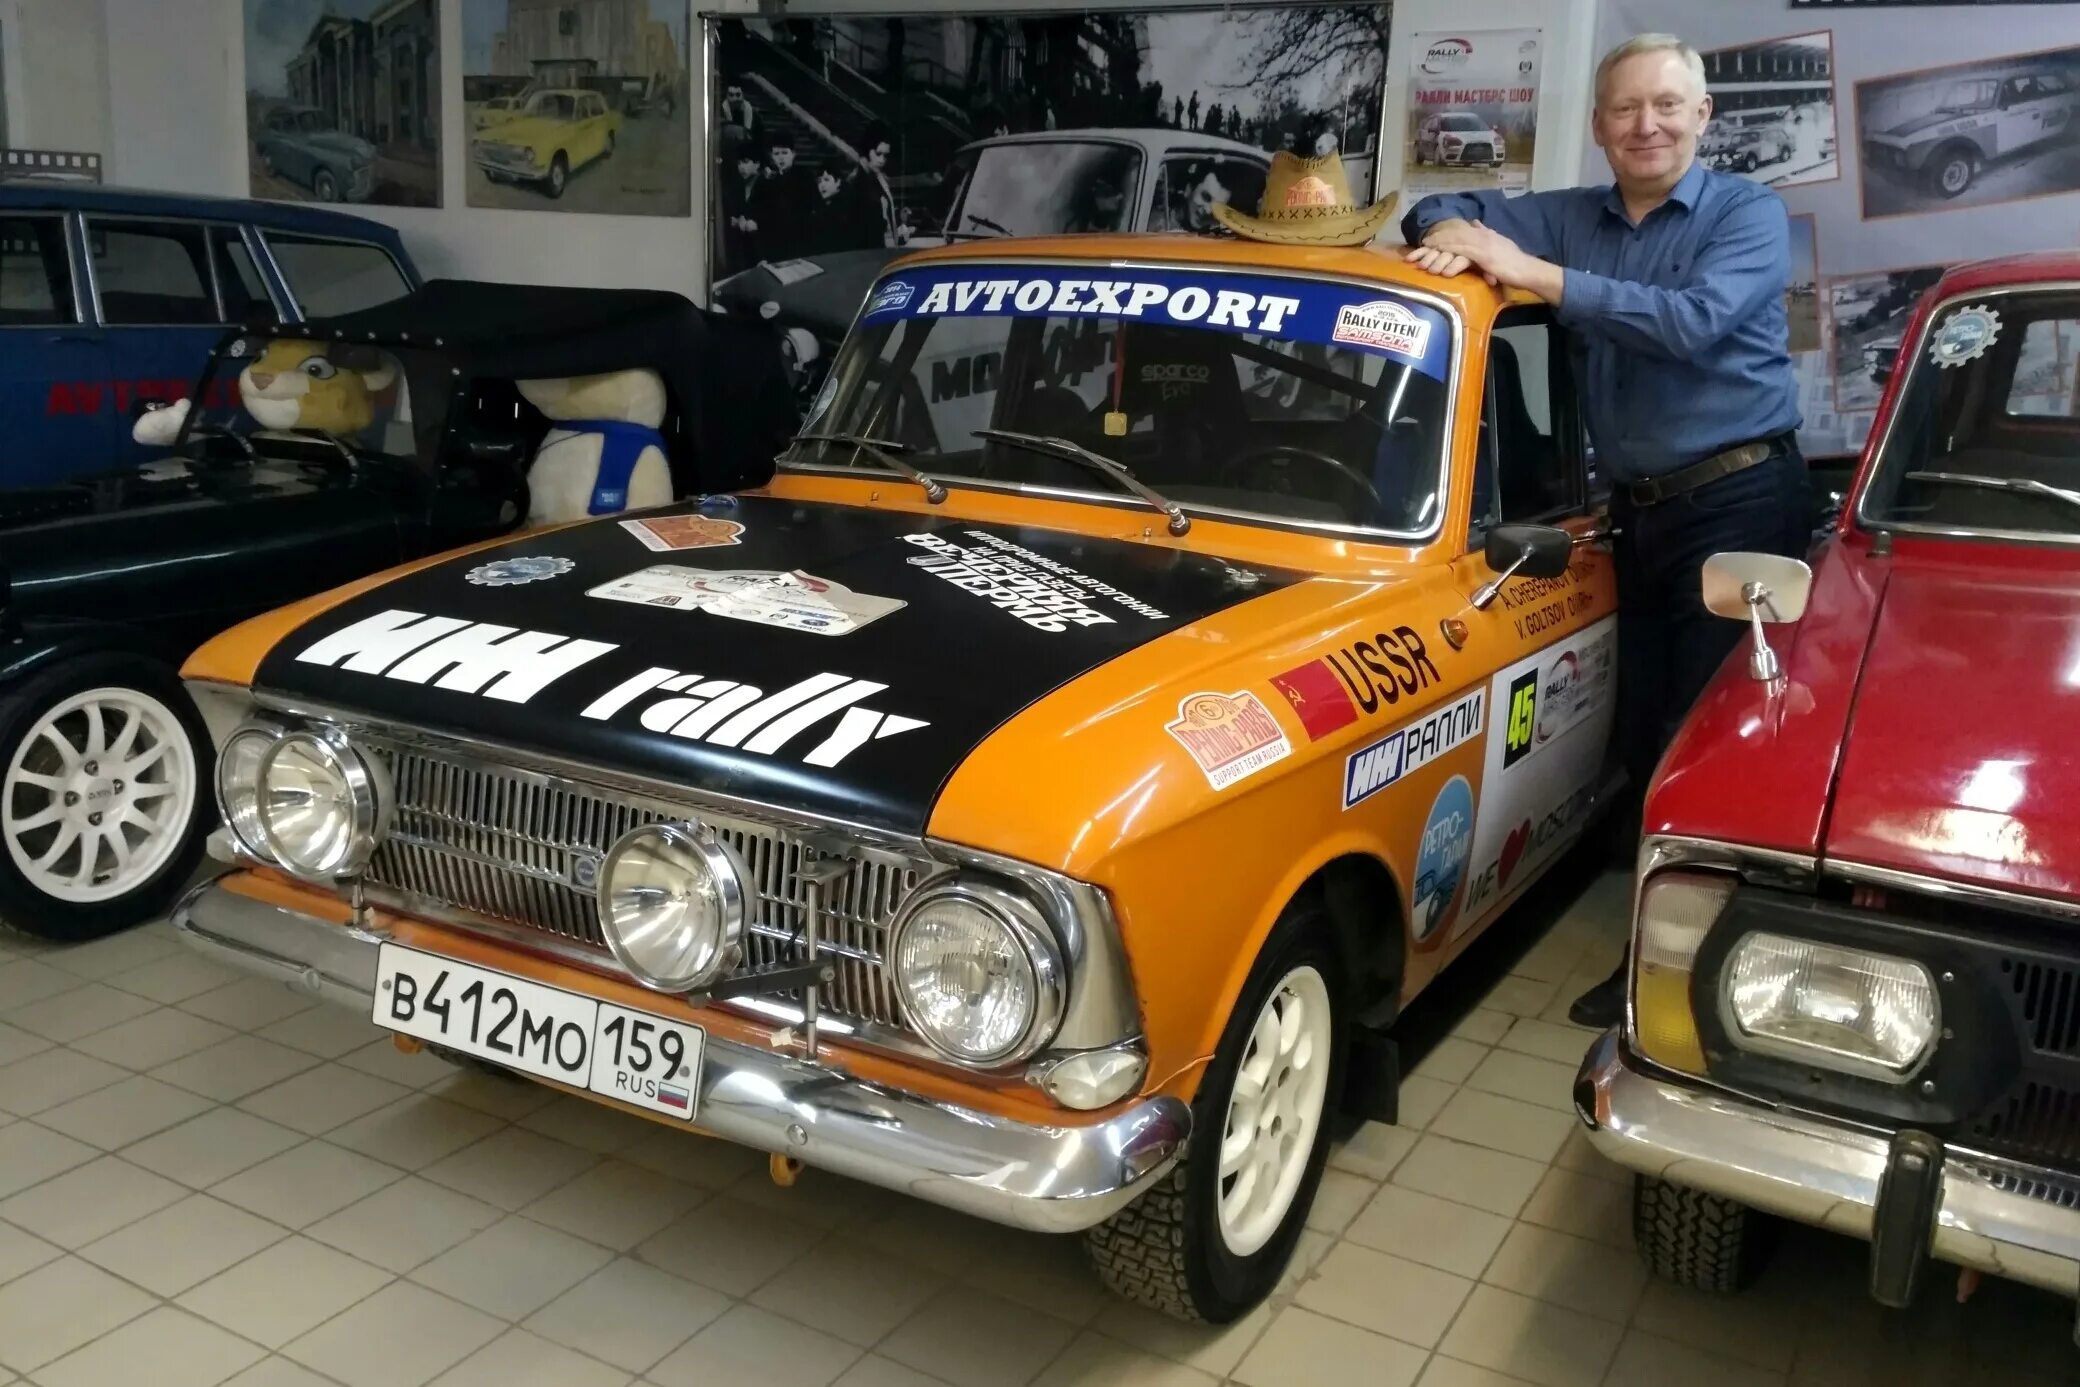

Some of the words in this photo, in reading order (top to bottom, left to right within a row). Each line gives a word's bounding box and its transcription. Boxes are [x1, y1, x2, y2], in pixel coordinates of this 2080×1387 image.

[1427, 48, 1460, 56] RALLY
[1415, 89, 1450, 104] РАЛЛИ
[1454, 88, 1506, 104] МАСТЕРС
[1510, 87, 1535, 103] ШОУ
[916, 279, 1300, 332] AVTOEXPORT
[1342, 311, 1380, 329] RALLY
[902, 532, 1118, 627] ВЕЧЕРНЯЯ
[921, 562, 1067, 633] ПЕРМЬ
[991, 555, 1037, 573] ПРИЗ
[1026, 572, 1097, 600] ГАЗЕТЫ
[1066, 574, 1170, 620] АВТОГОНКИ
[1514, 619, 1527, 640] V.
[1525, 600, 1566, 635] GOLTSOV
[1325, 626, 1441, 714] USSR
[580, 666, 931, 768] rally
[1404, 695, 1481, 770] РАЛЛИ
[1508, 682, 1535, 751] 45
[1213, 763, 1245, 785] SUPPORT
[1243, 753, 1264, 771] TEAM
[1261, 742, 1286, 762] RUSSIA
[391, 970, 587, 1072] В412МО
[603, 1016, 685, 1080] 159
[615, 1070, 656, 1098] RUS
